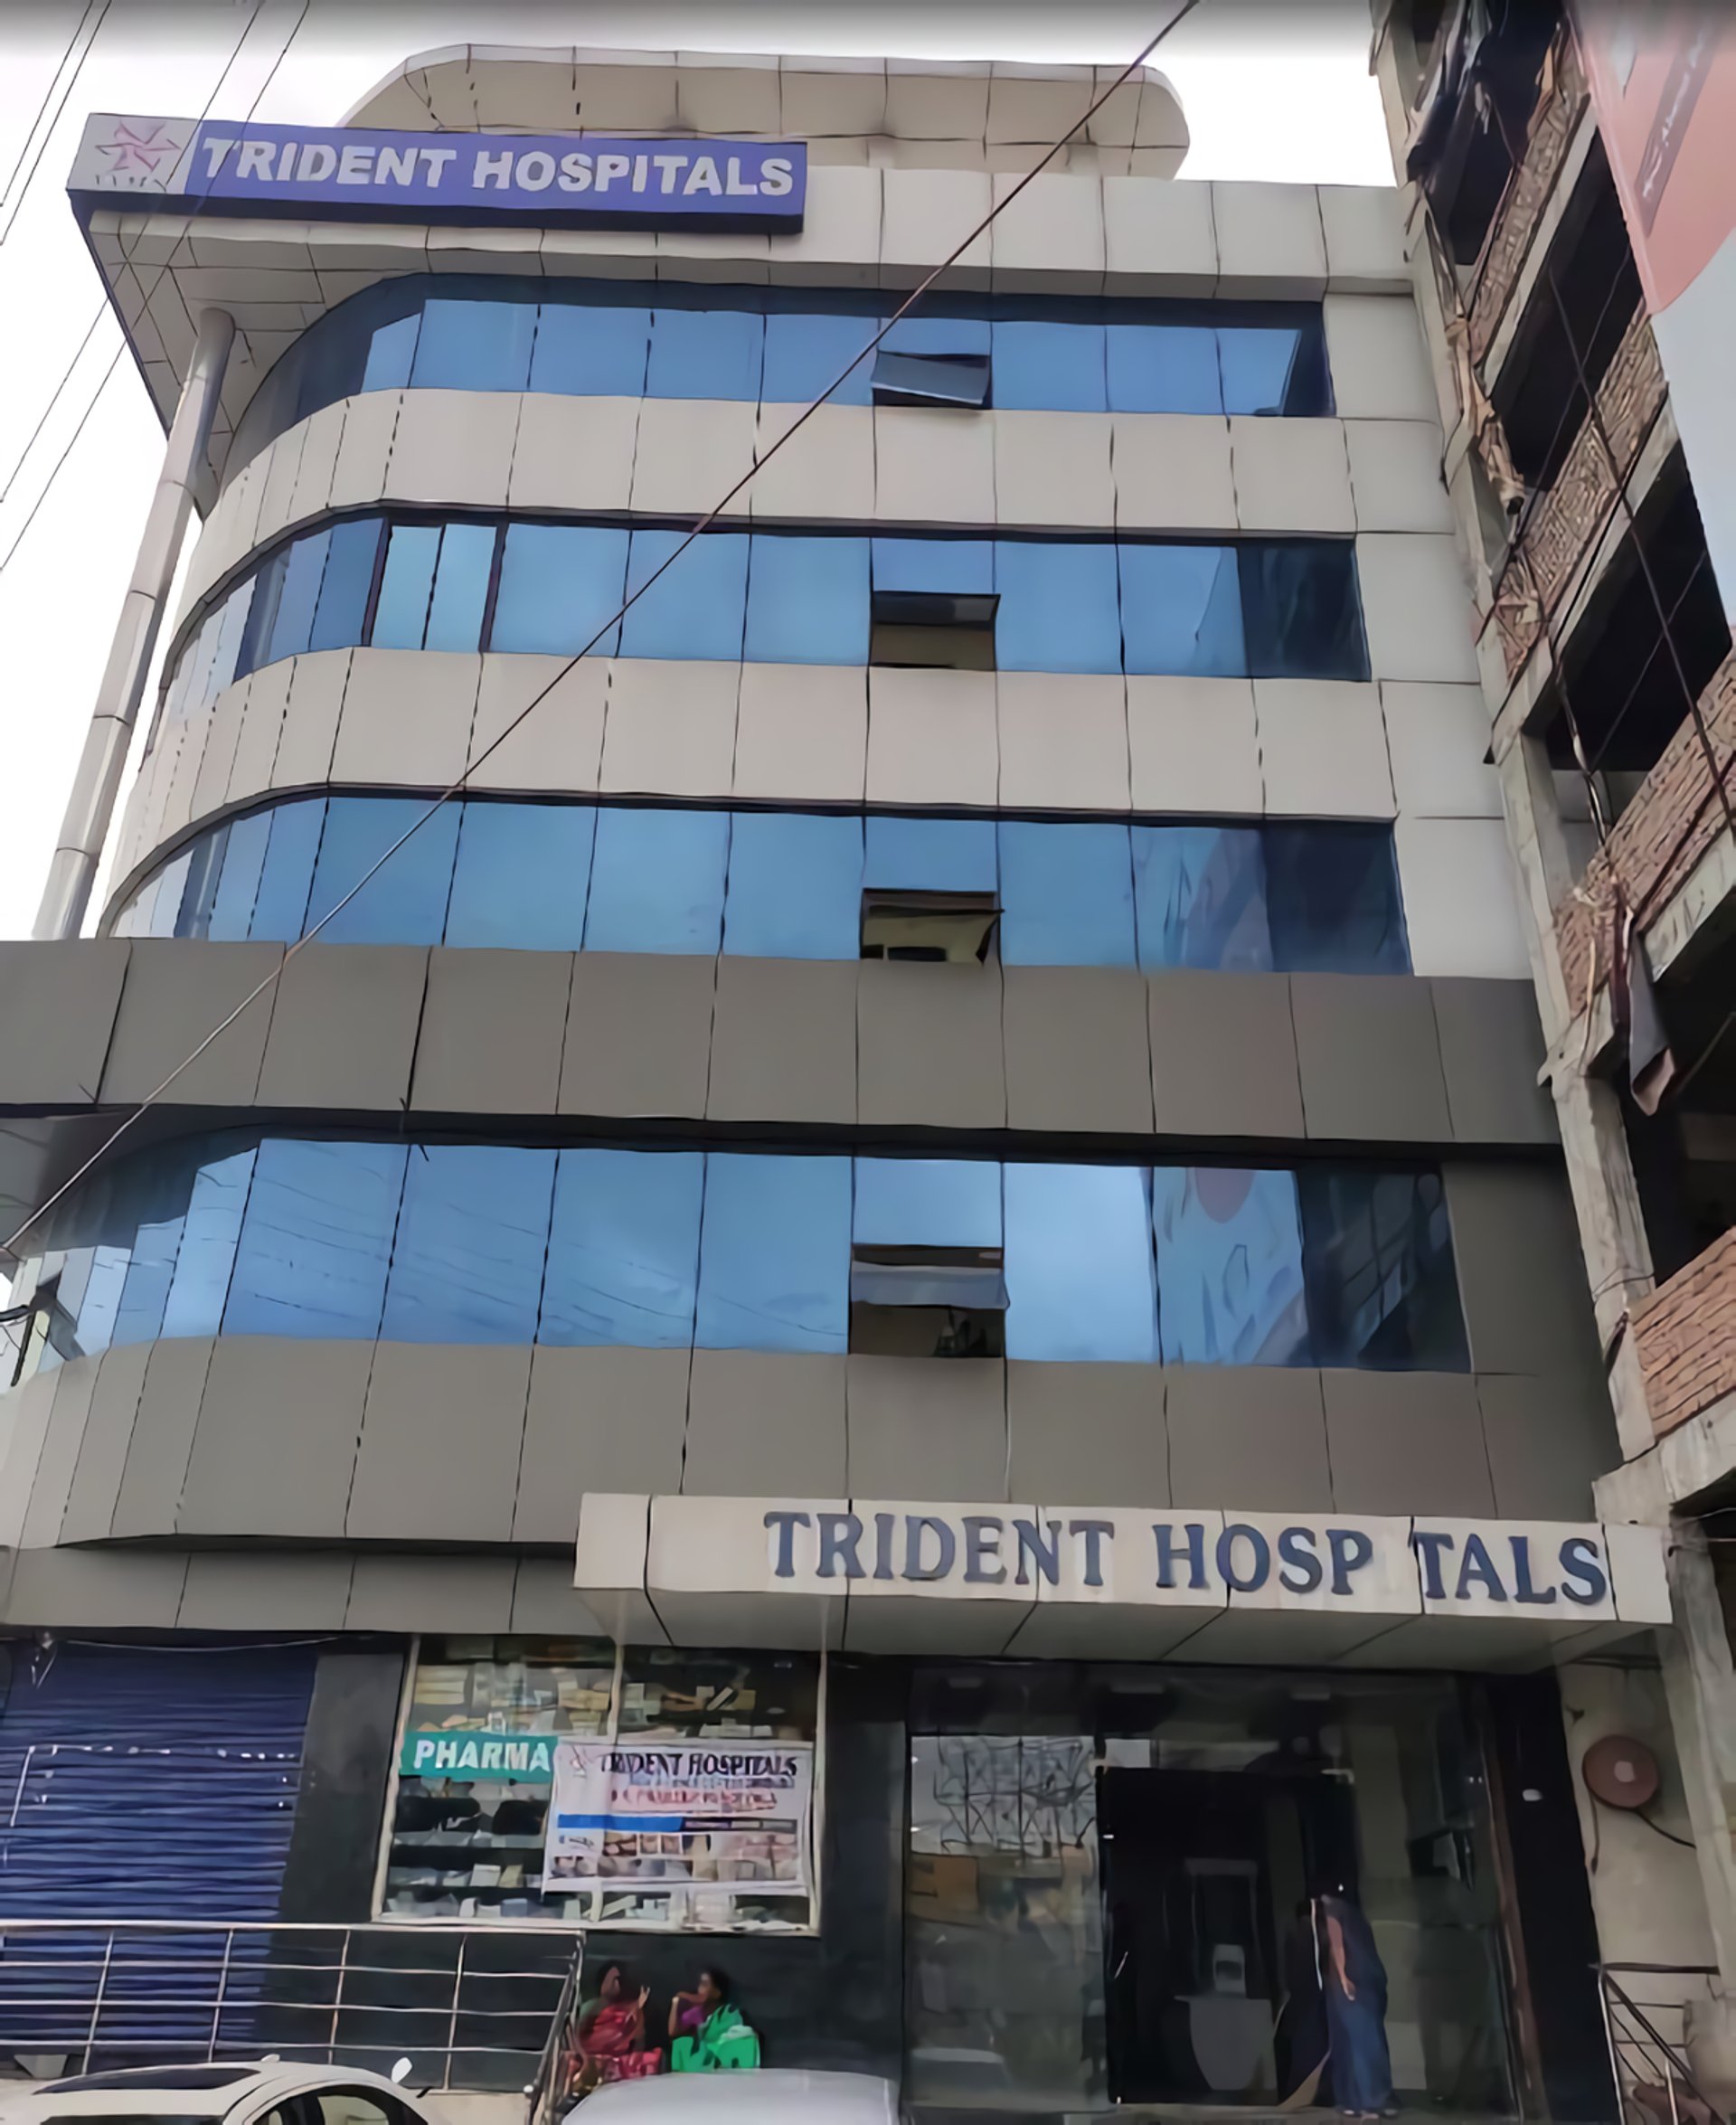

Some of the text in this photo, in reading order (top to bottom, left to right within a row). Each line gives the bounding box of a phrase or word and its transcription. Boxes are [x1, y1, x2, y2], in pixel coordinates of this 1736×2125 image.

[202, 137, 794, 198] TRIDENT HOSPITALS
[763, 1511, 1115, 1586] TRIDENT
[413, 1739, 551, 1772] PHARMA
